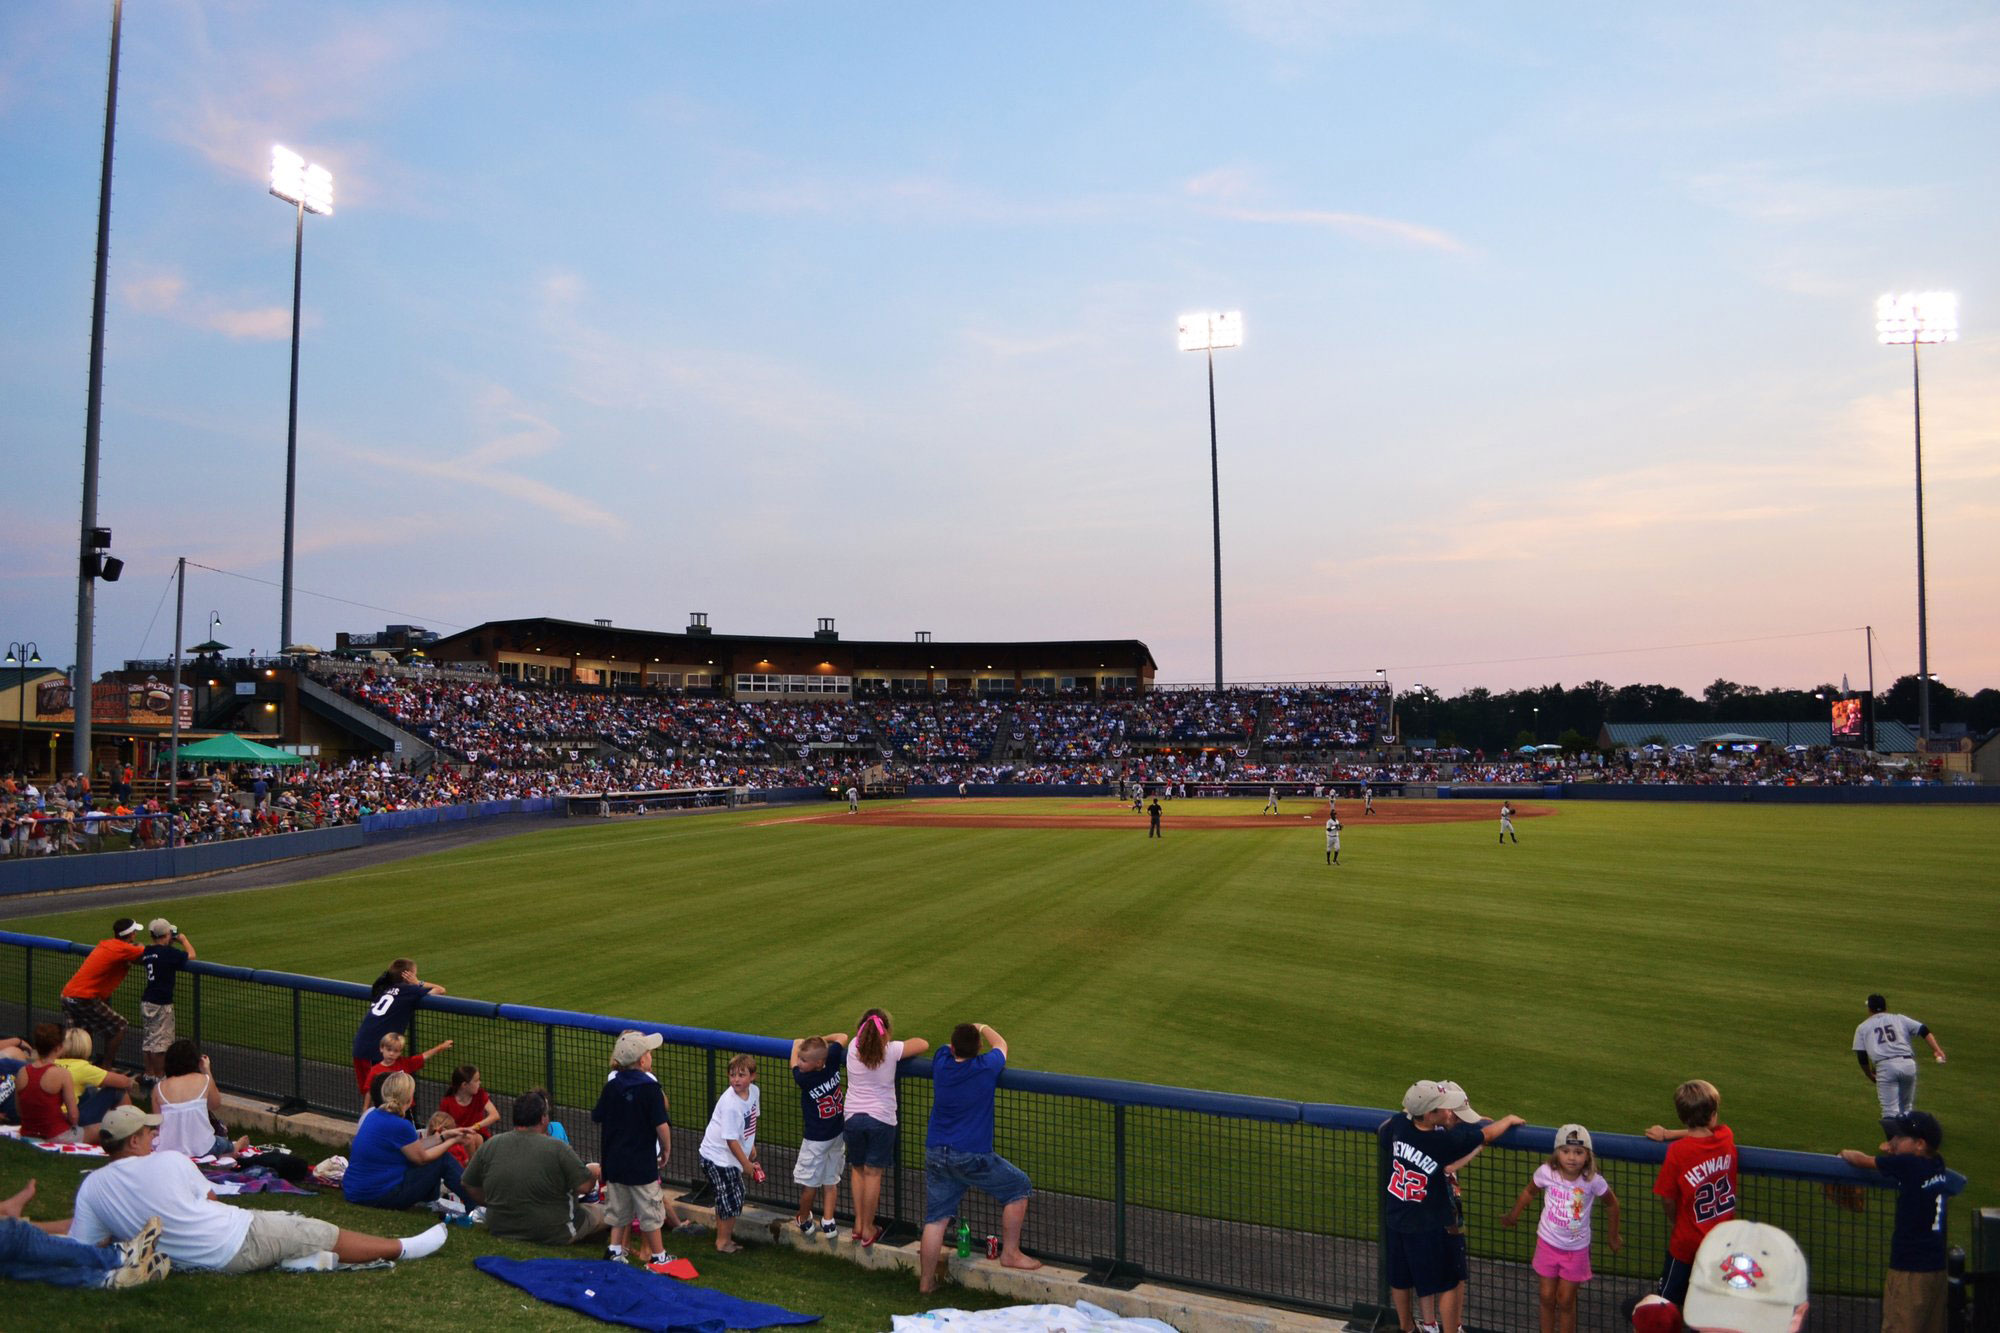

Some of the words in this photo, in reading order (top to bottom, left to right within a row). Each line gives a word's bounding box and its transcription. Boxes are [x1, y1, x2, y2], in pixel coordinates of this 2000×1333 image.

[1874, 1024, 1896, 1045] 25
[815, 1087, 844, 1119] 22
[1387, 1158, 1429, 1203] 22
[1693, 1173, 1736, 1224] 22
[1931, 1193, 1942, 1231] 1
